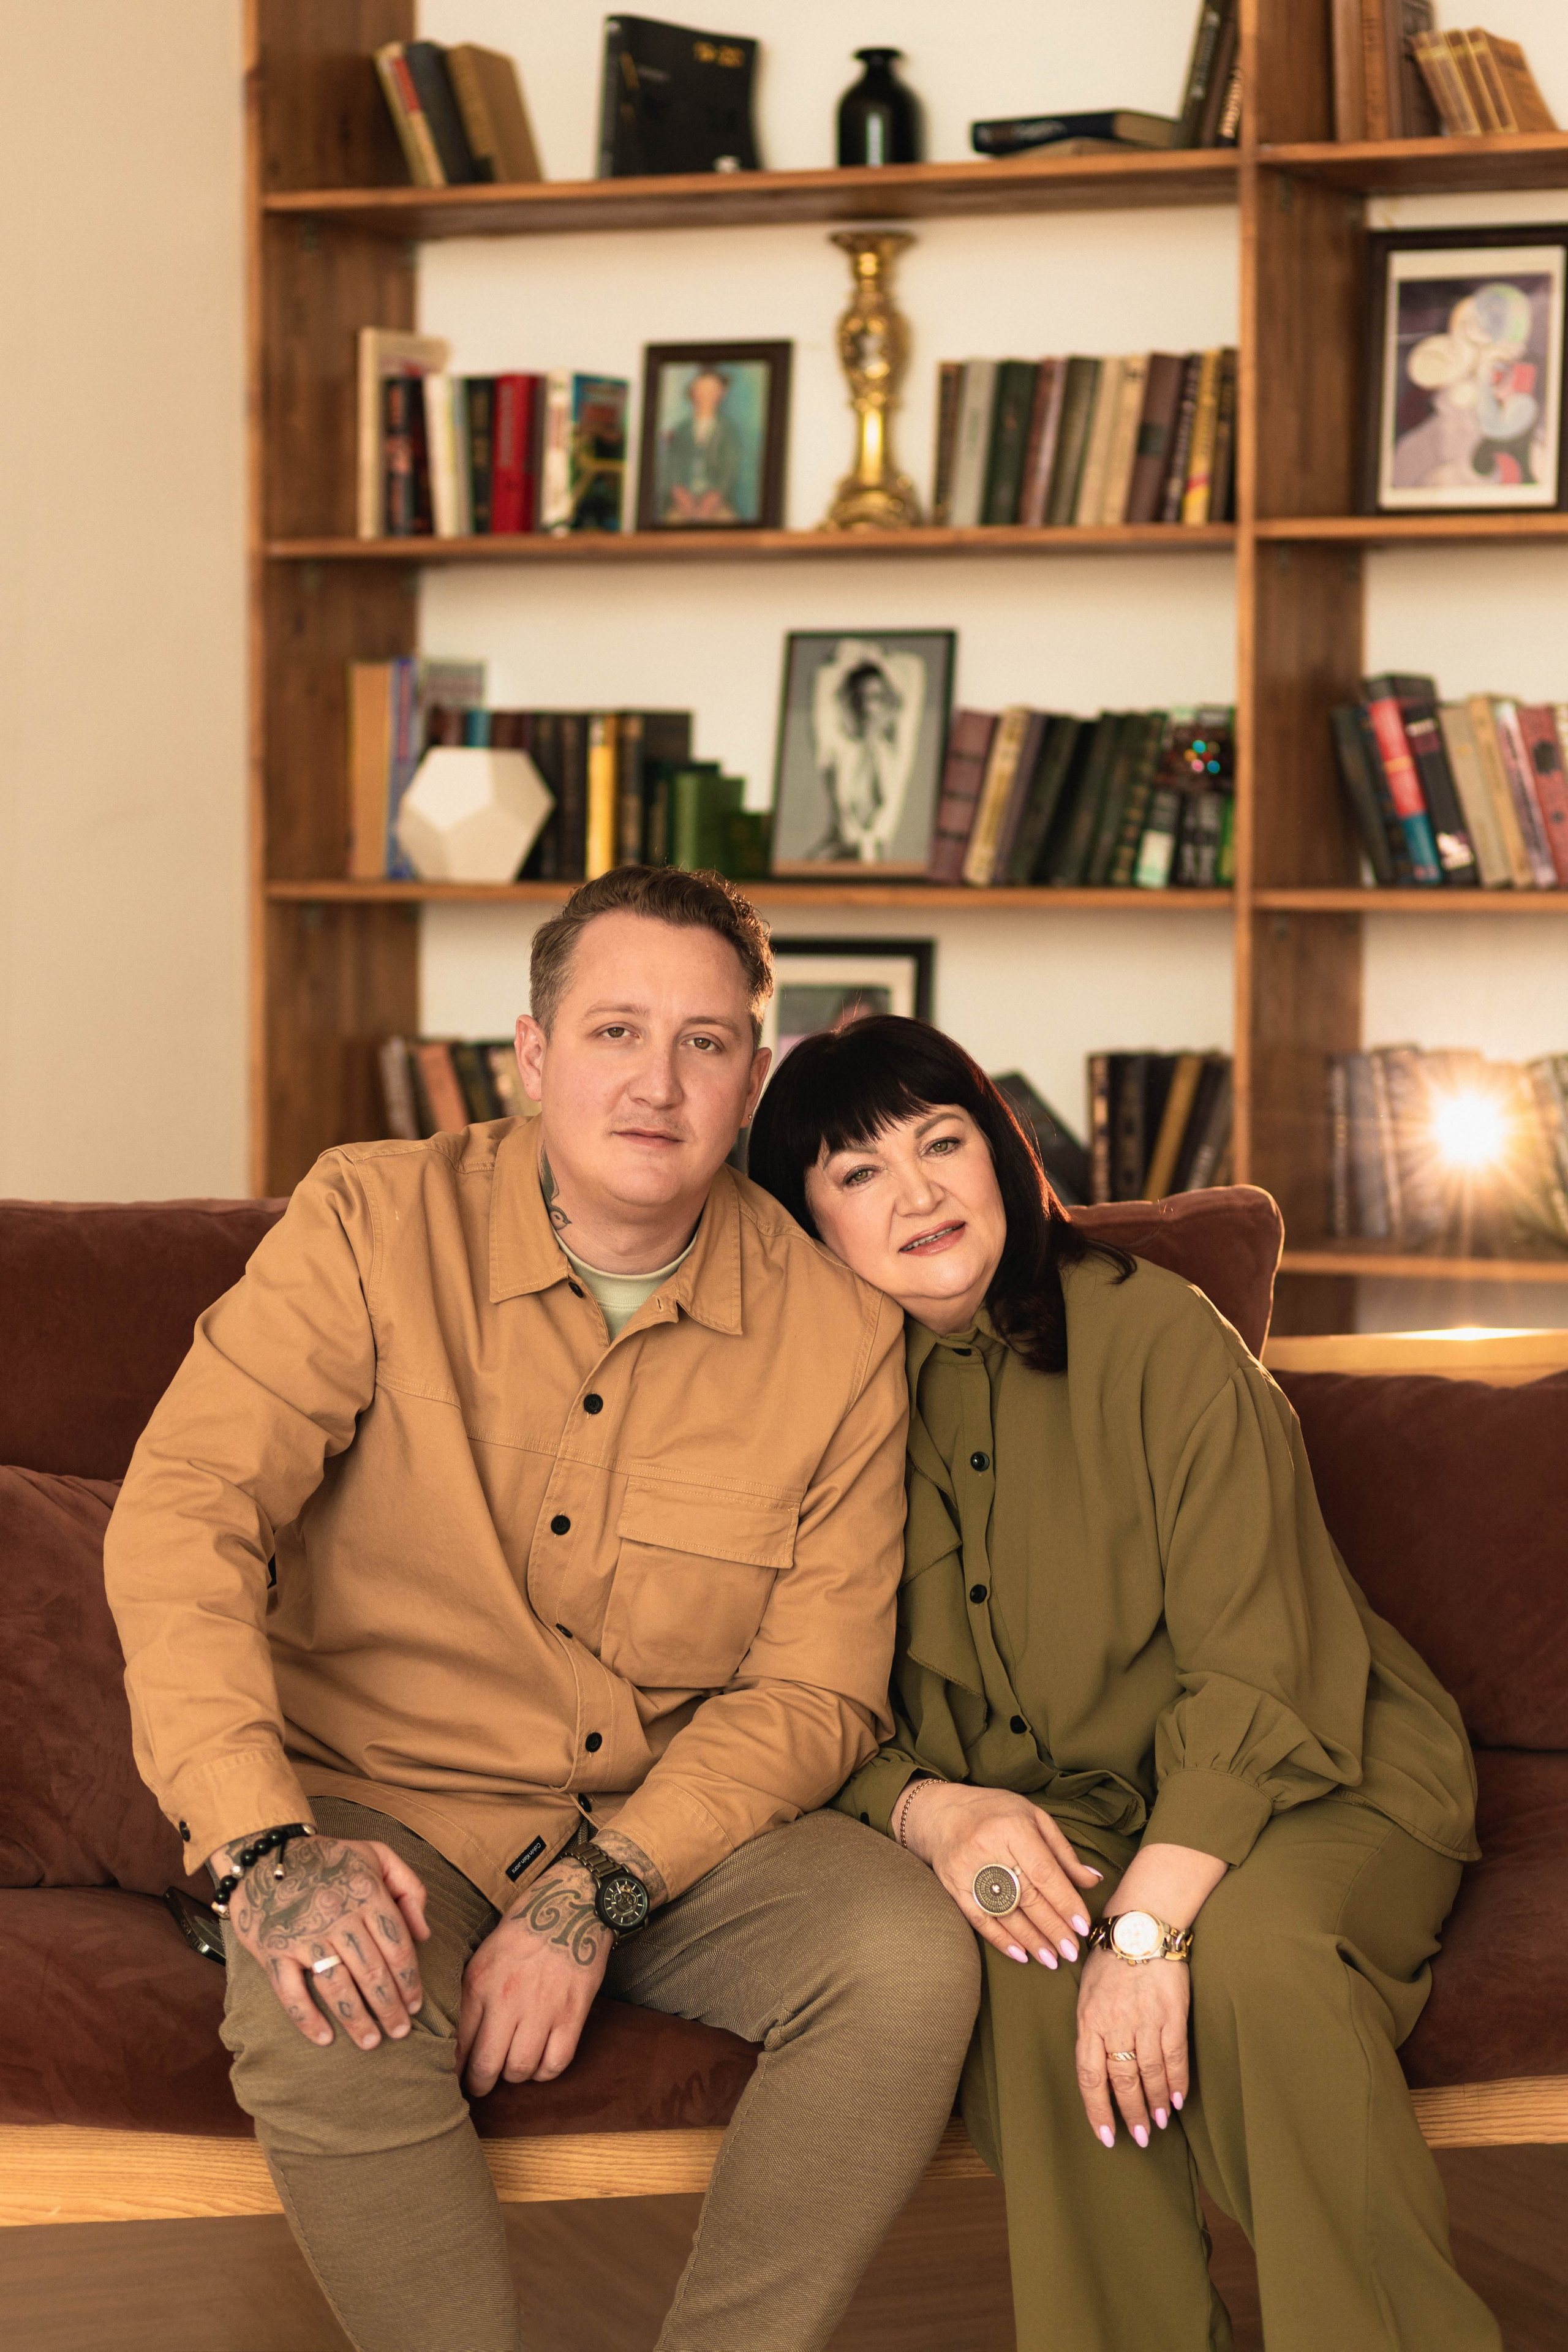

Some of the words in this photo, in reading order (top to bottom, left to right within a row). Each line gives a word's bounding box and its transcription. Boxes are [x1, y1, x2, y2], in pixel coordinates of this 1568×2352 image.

[529, 1842, 541, 1855] Calvin
[521, 1853, 531, 1864] Klein
[511, 1862, 521, 1874] Jeans
